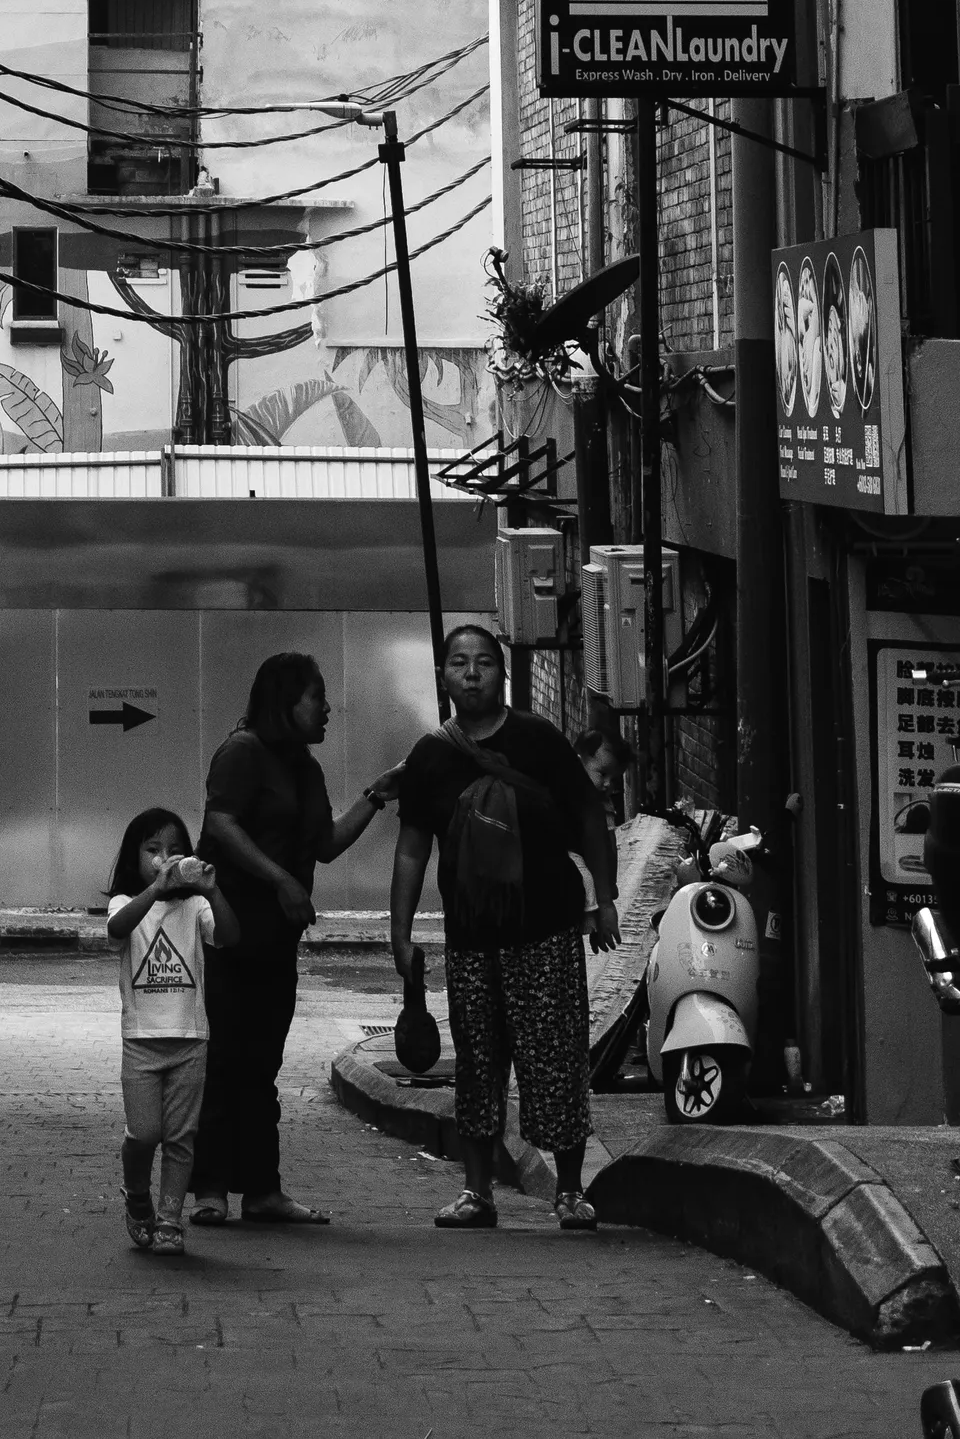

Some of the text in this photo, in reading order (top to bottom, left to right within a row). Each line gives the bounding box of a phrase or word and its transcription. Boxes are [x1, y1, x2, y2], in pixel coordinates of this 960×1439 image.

[575, 69, 771, 82] Express Wash Dry Iron Delivery
[898, 768, 935, 787] 洗发
[146, 975, 183, 984] SACRIFICE
